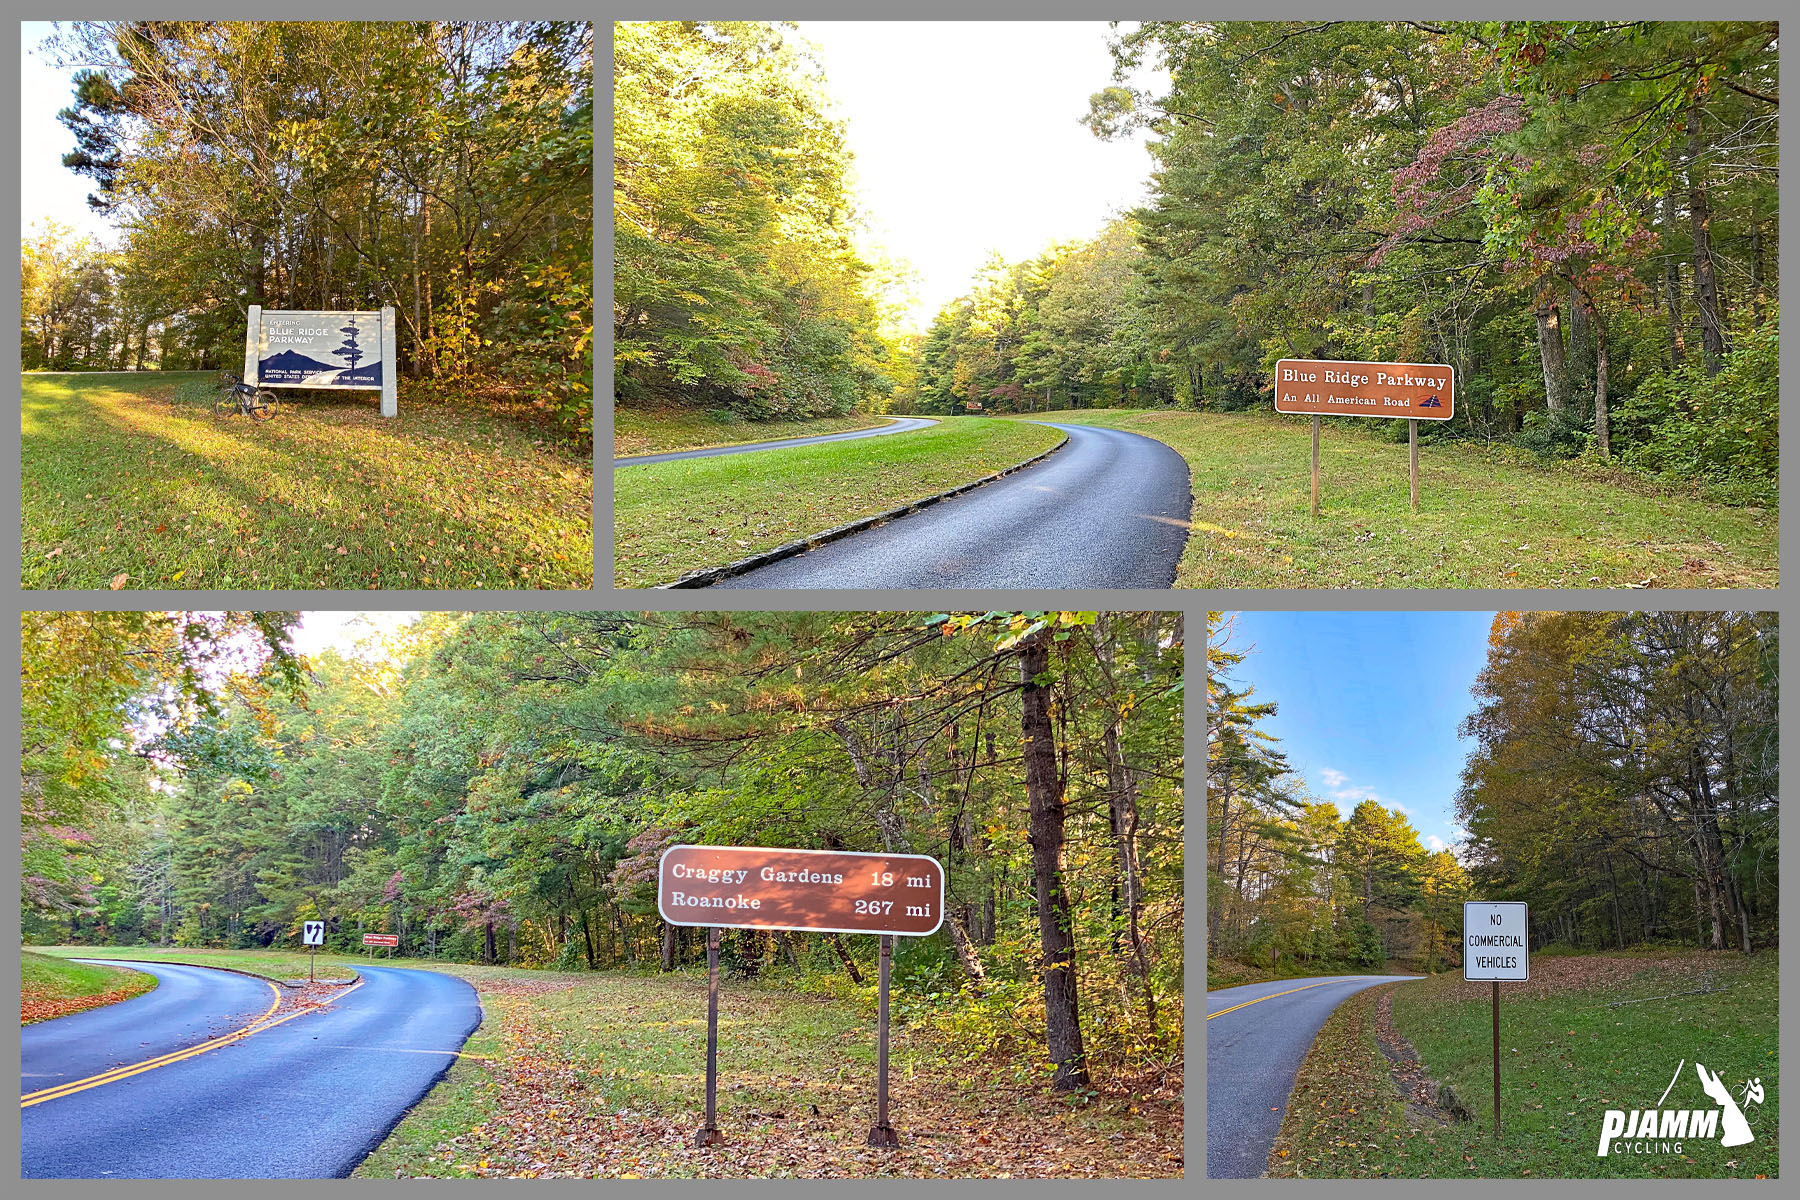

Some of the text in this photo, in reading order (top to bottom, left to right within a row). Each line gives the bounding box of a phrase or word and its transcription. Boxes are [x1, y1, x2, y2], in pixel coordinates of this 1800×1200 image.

[269, 327, 329, 336] BLUE RIDGE
[269, 335, 314, 344] PARKWAY
[1282, 369, 1447, 391] Blue Ridge Parkway
[1282, 392, 1411, 407] An All American Road
[672, 863, 932, 889] Craggy Gardens 18 mi
[671, 891, 931, 918] Roanoke 267 mi
[1490, 914, 1502, 926] NO
[1468, 935, 1524, 947] COMMERCIAL
[1476, 956, 1517, 969] VEHICLES
